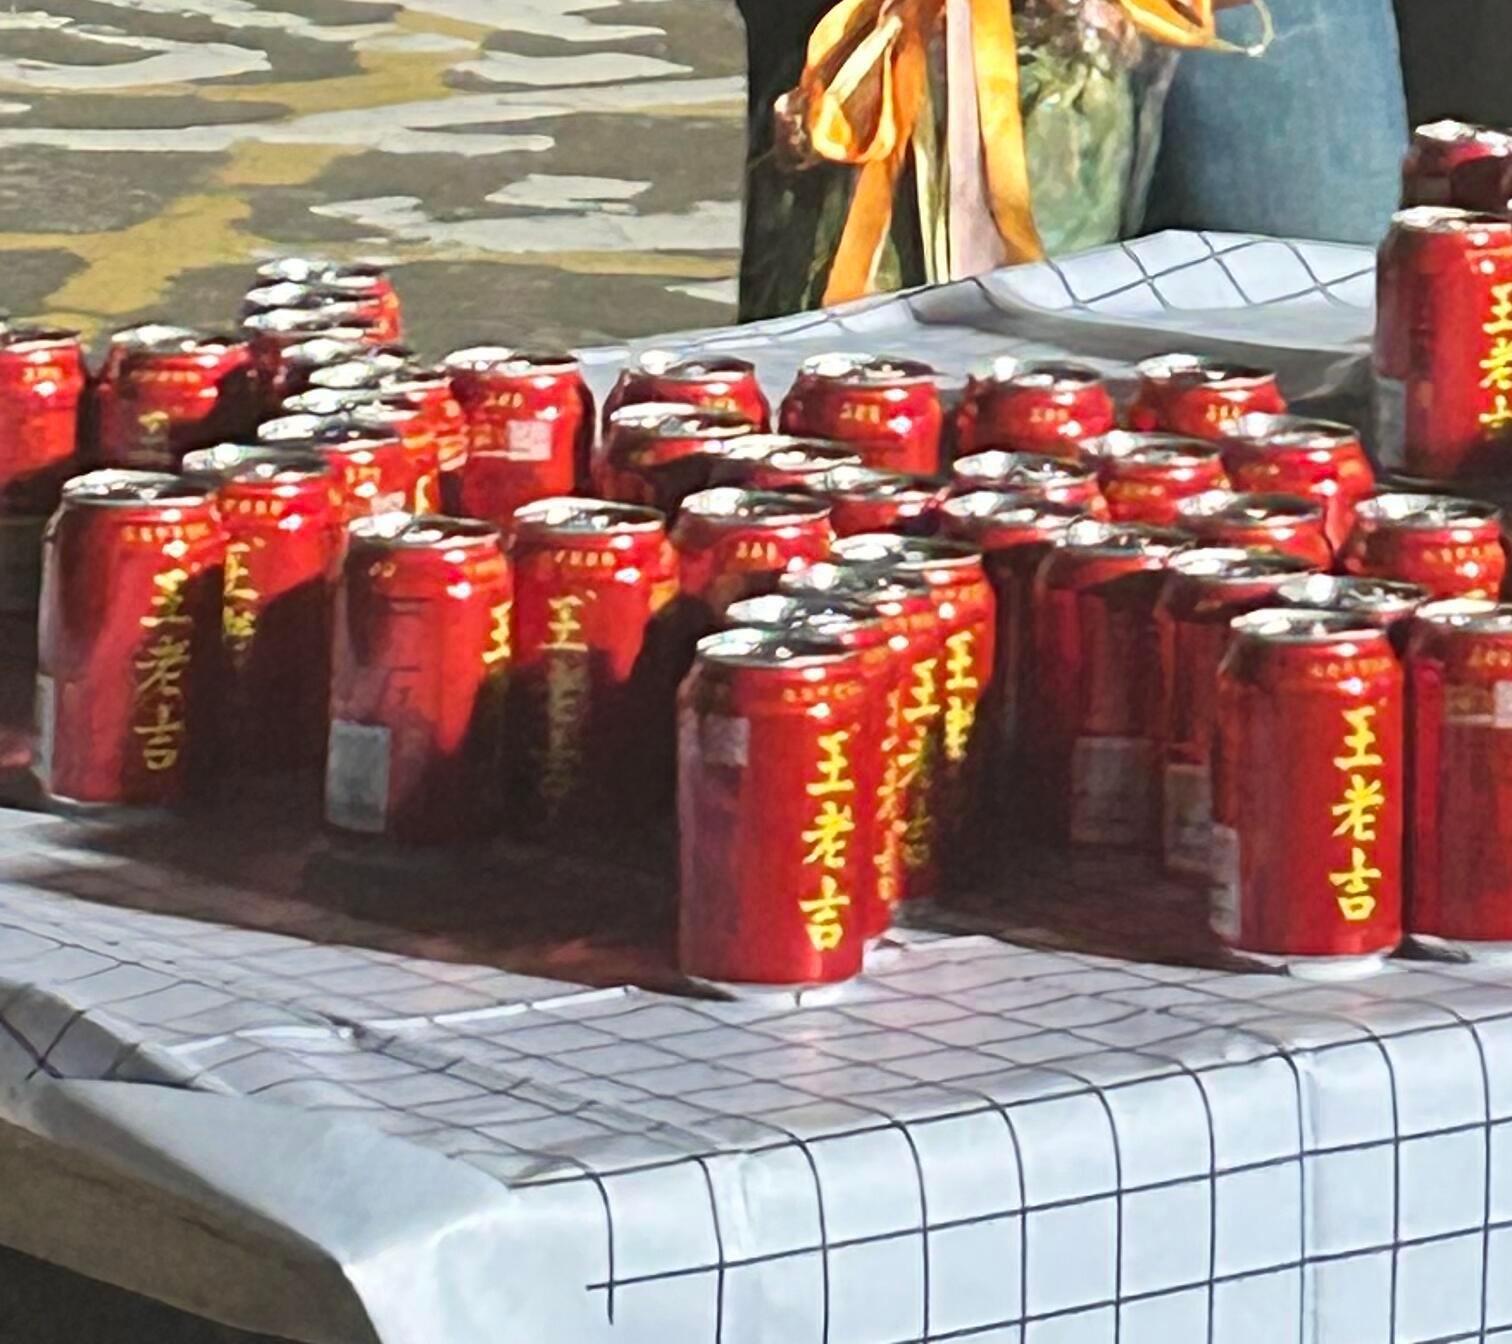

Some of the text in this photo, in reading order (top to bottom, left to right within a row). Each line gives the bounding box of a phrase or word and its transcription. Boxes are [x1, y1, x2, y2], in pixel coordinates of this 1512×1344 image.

[133, 568, 192, 770] 王老吉
[798, 730, 856, 952] 王老吉
[1329, 705, 1385, 920] 王老吉
